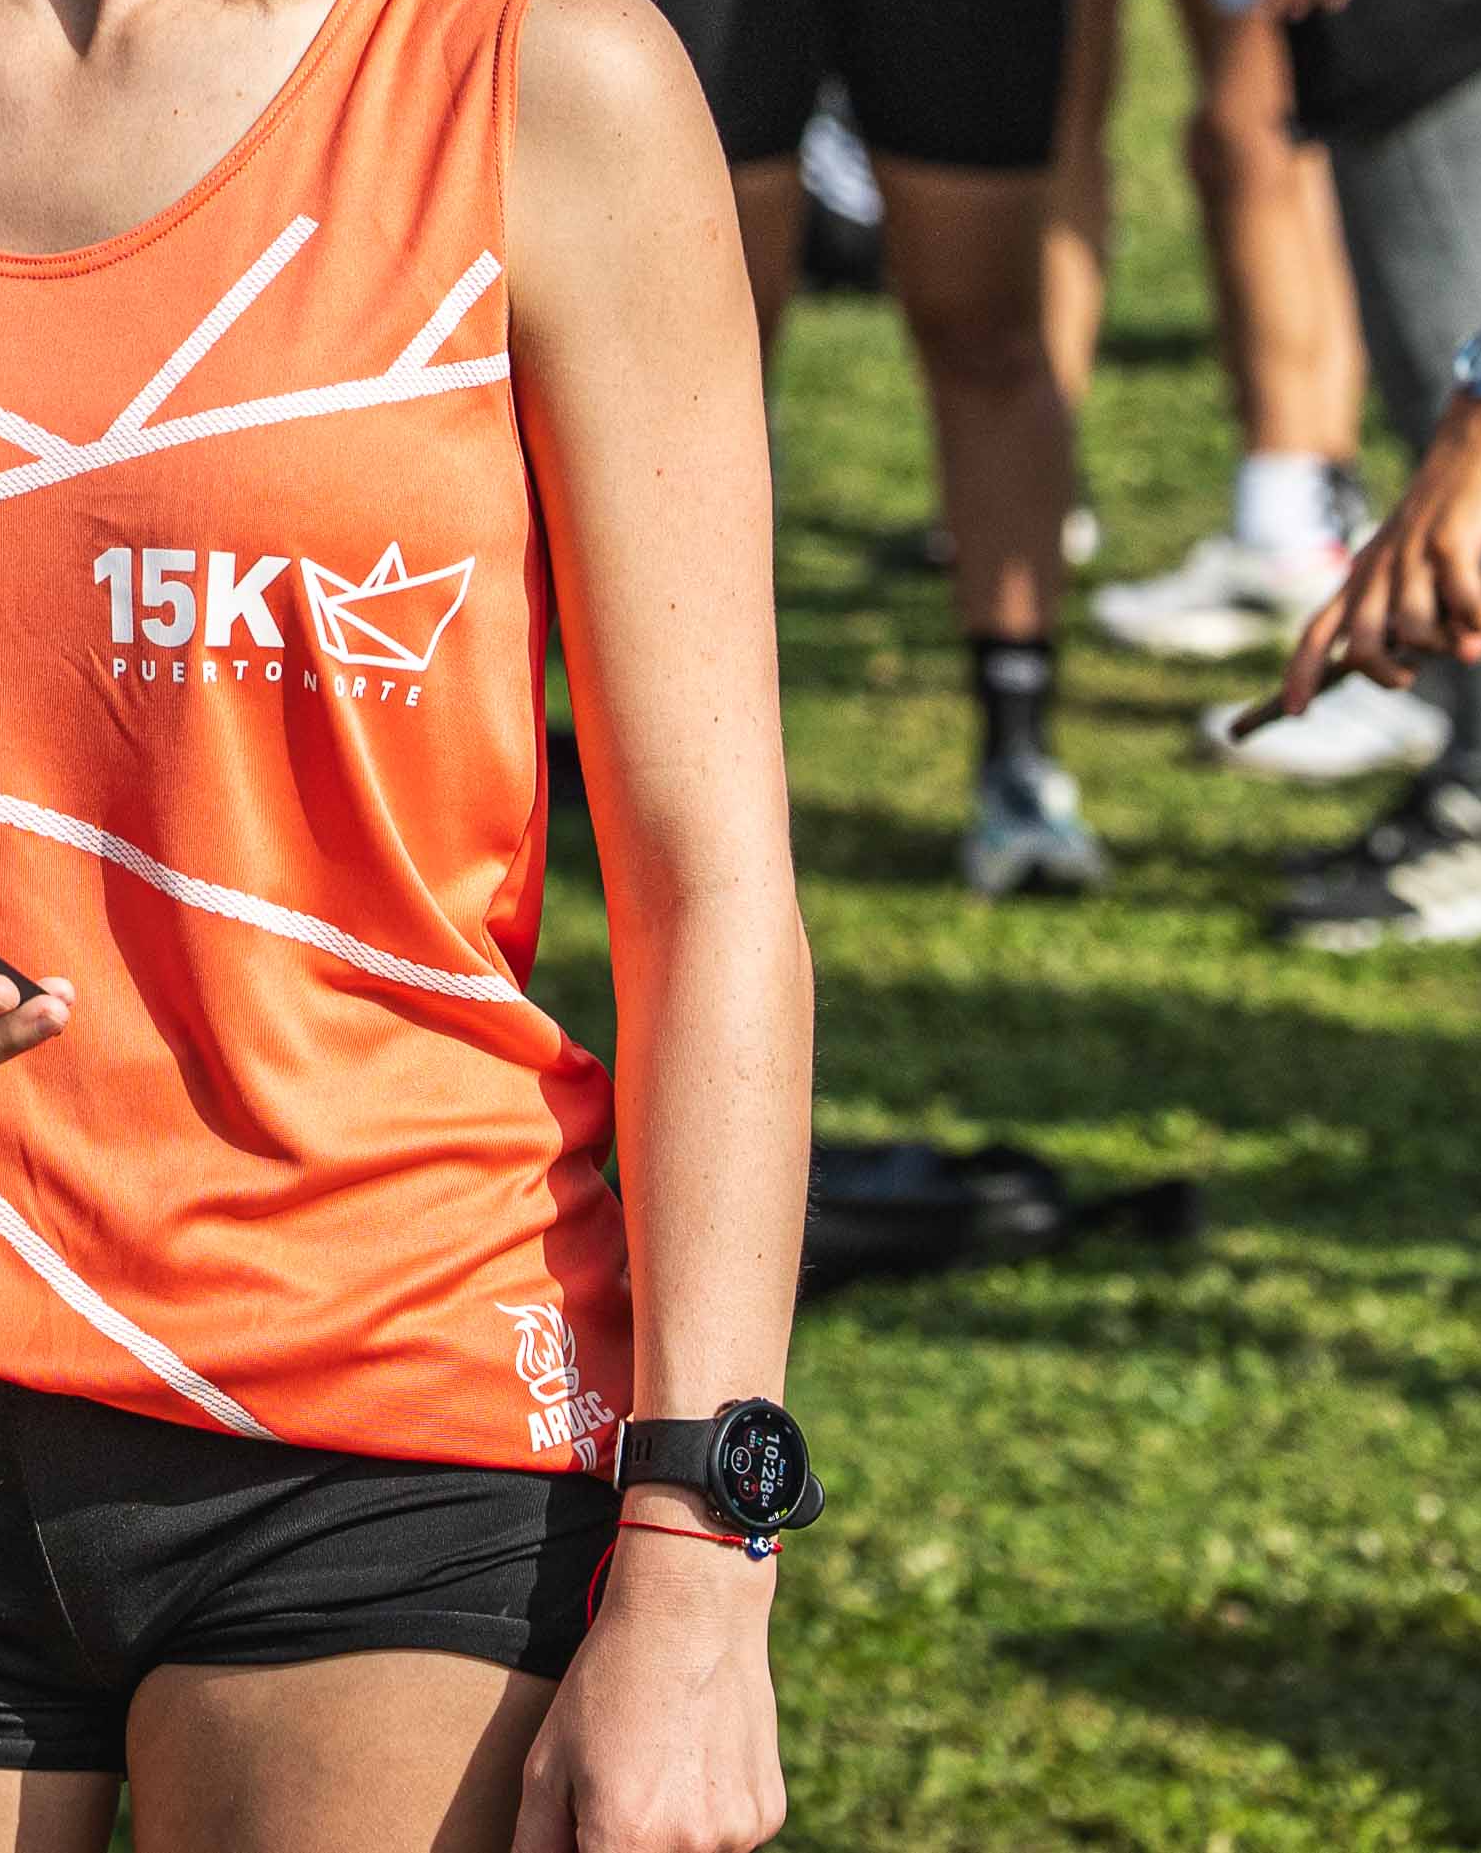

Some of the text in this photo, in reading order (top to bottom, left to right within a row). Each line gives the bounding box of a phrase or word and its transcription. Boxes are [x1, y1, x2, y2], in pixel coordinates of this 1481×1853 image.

[93, 546, 292, 649] 15K
[112, 657, 422, 708] PUERTO NORTE
[759, 1433, 781, 1495] 10:28
